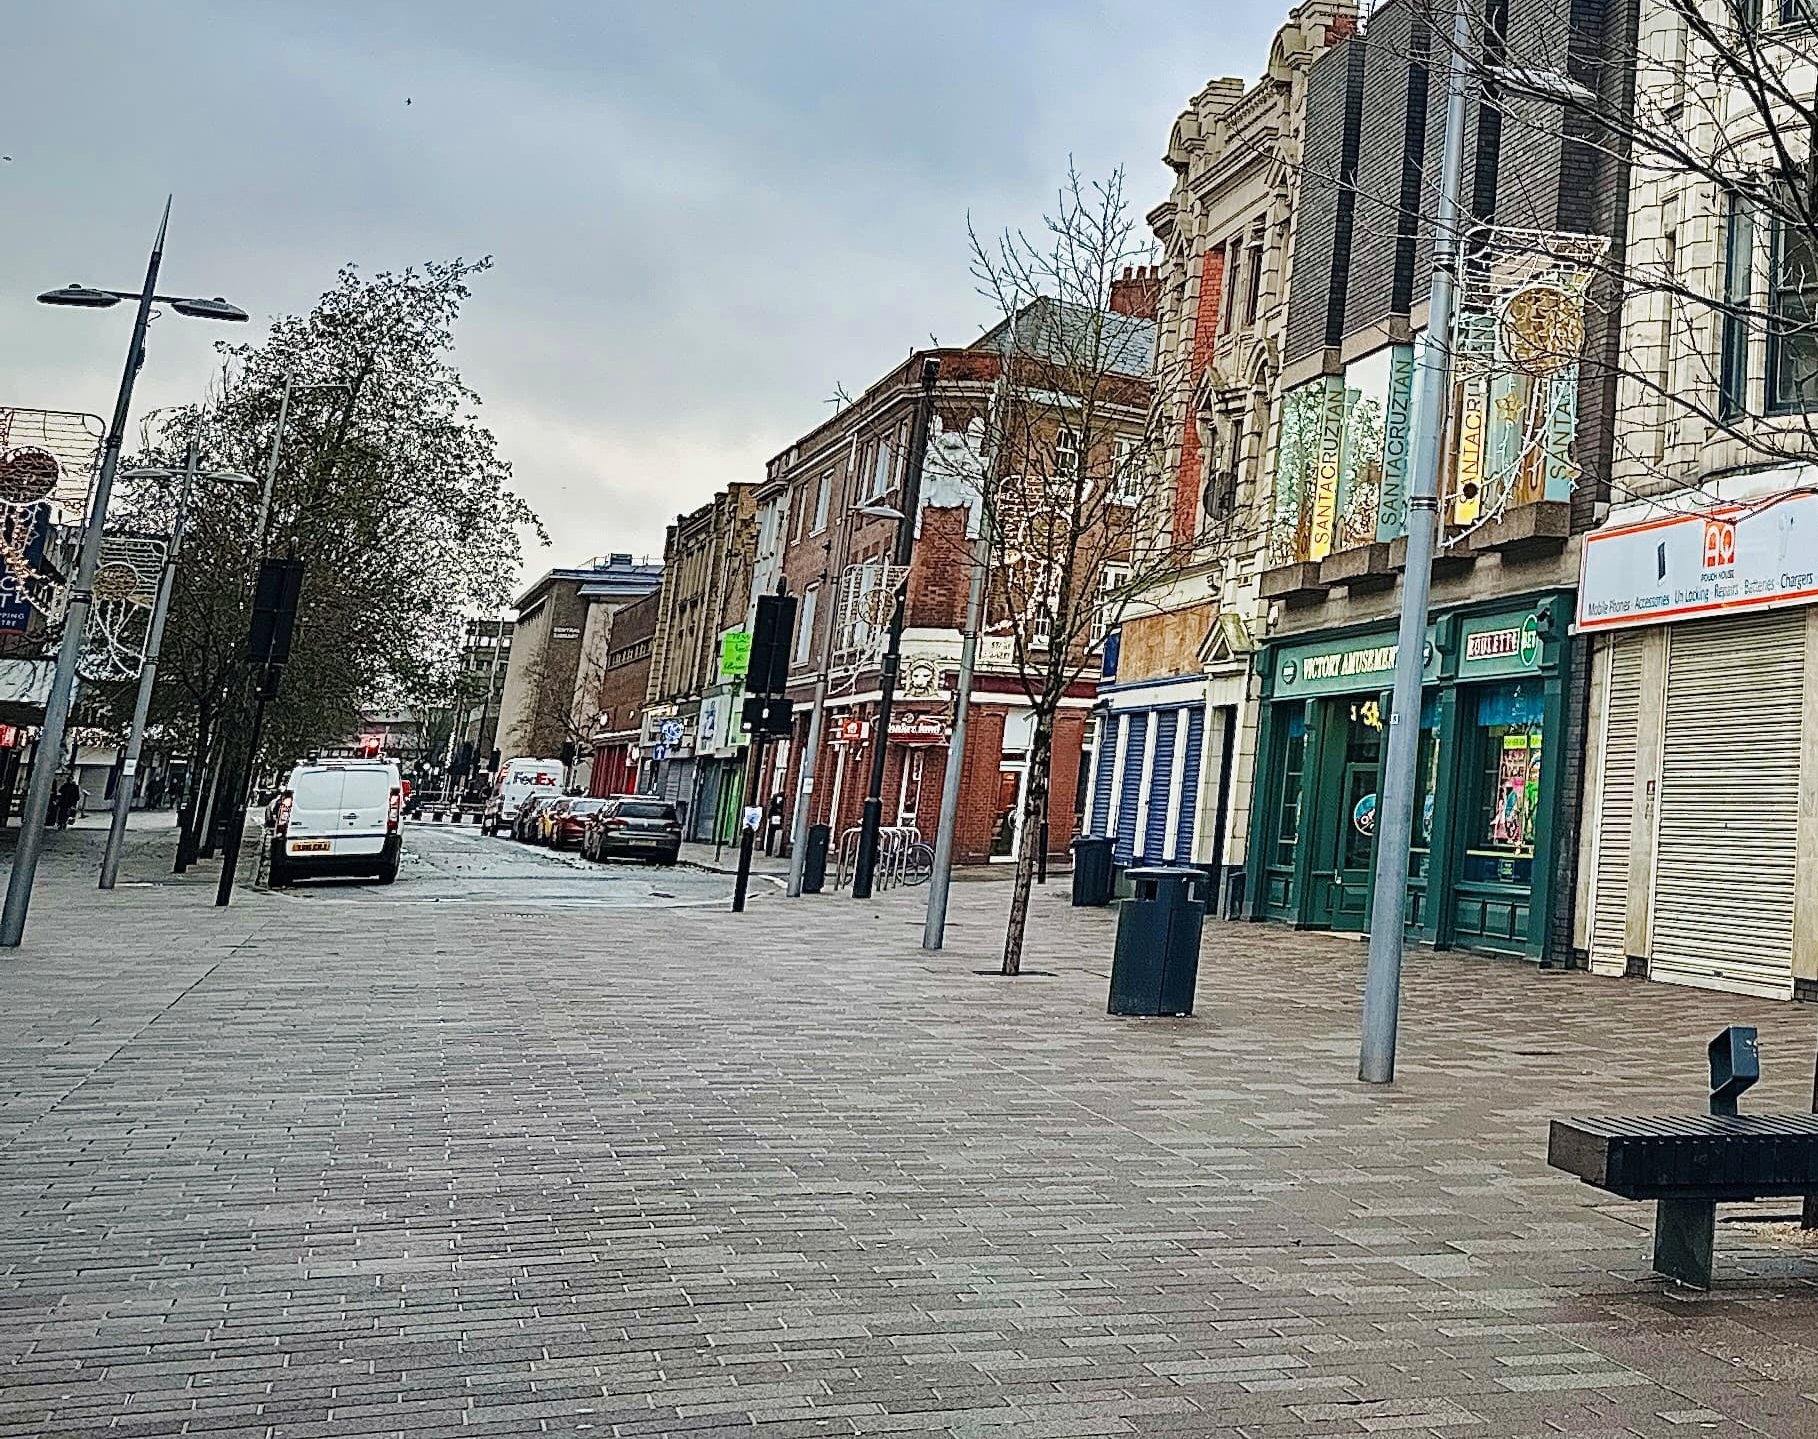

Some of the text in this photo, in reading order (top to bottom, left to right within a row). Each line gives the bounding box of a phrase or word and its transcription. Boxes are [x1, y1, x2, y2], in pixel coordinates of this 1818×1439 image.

[1381, 360, 1411, 526] SANTACRUZTAN
[1314, 390, 1343, 545] SANTACRUZTAN
[1780, 572, 1814, 591] Chargers
[1303, 653, 1341, 680] VICTORY
[512, 771, 556, 786] FedEx
